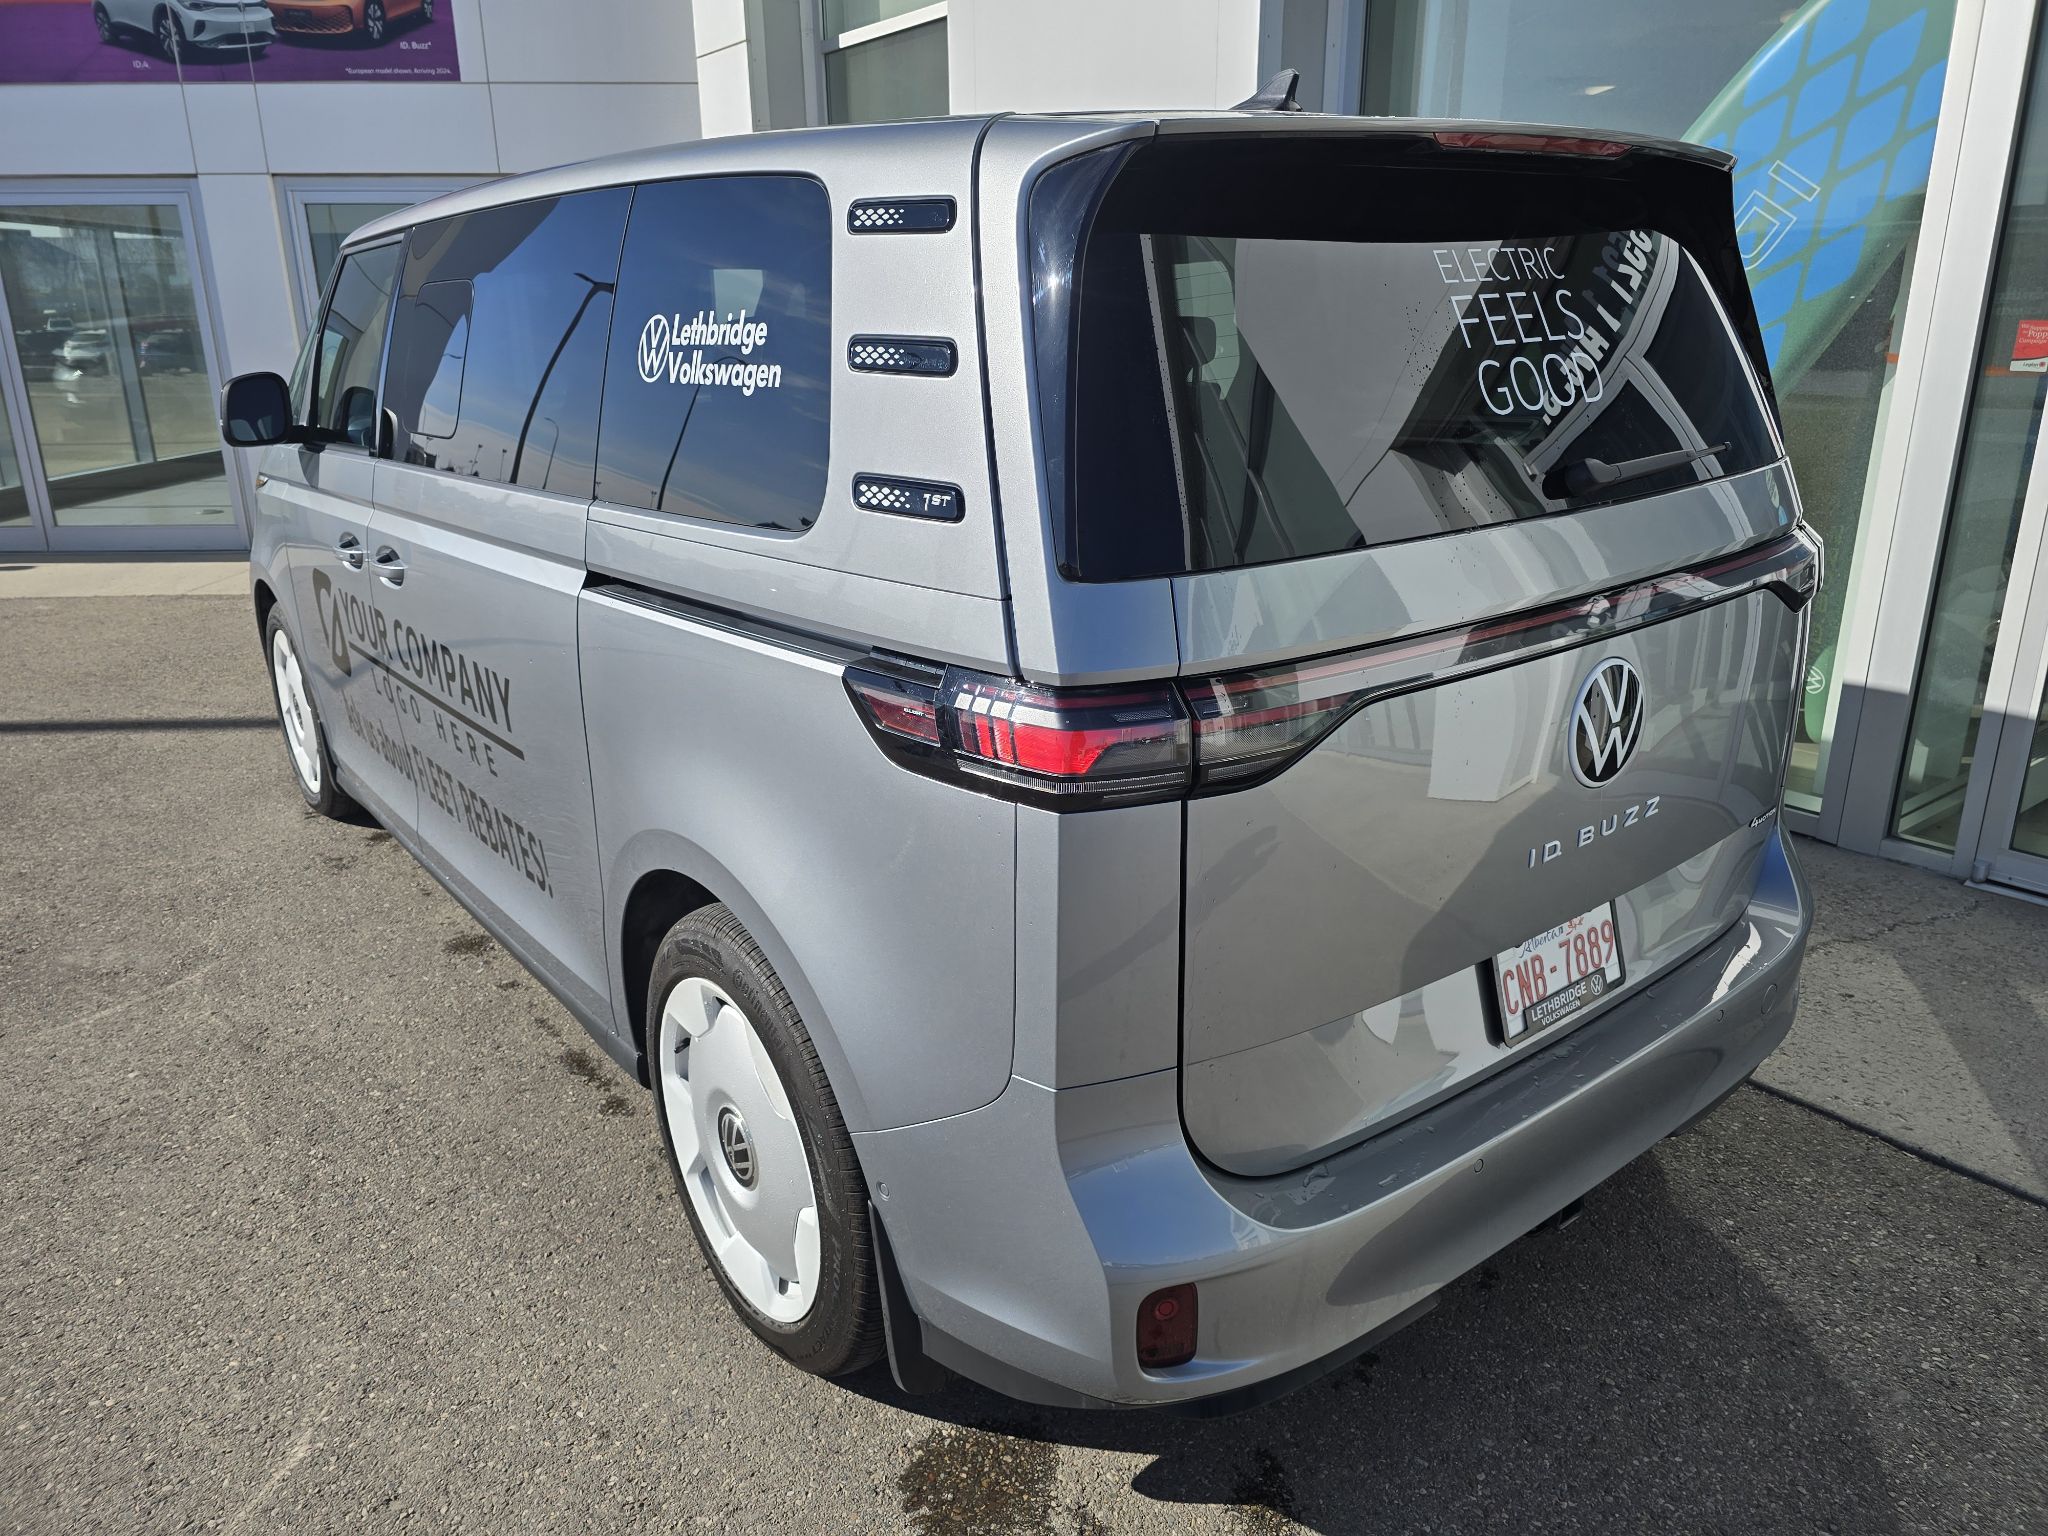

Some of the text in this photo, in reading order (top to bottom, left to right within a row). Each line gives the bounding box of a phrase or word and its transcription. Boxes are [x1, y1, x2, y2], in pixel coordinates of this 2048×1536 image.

[1433, 246, 1565, 284] ELECTRIC
[671, 309, 768, 355] Lethbridge
[1450, 289, 1585, 348] FEELS
[668, 350, 782, 396] Volkswagen
[1478, 352, 1604, 416] GOOD
[338, 588, 513, 734] YOUR COMPANY
[371, 668, 498, 778] LOGO HERE
[411, 743, 462, 824] FLEET
[457, 780, 554, 900] REBATES!
[1527, 795, 1661, 870] ID. BUZZ
[1502, 919, 1615, 1015] CNB-7889
[1531, 982, 1588, 1021] LETHBRIDGE
[1541, 1000, 1581, 1026] VOLKSWAGEN
